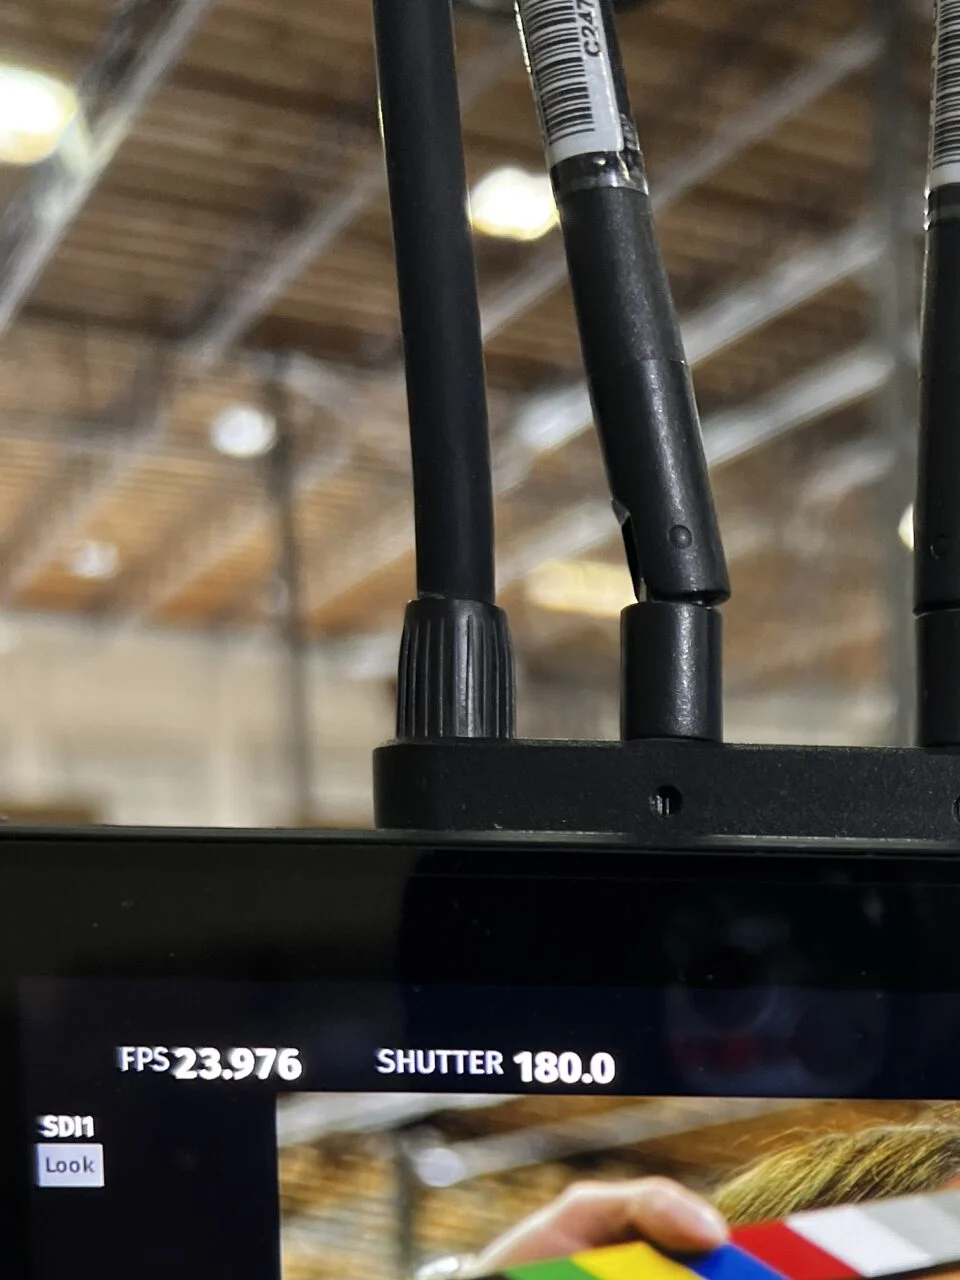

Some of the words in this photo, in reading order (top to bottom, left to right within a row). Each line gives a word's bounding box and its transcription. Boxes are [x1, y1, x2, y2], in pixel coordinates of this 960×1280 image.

[118, 1046, 169, 1072] FPS
[172, 1047, 302, 1080] 23.976
[376, 1048, 504, 1075] SHUTTER
[513, 1051, 616, 1084] 180.0
[46, 1156, 95, 1173] Look
